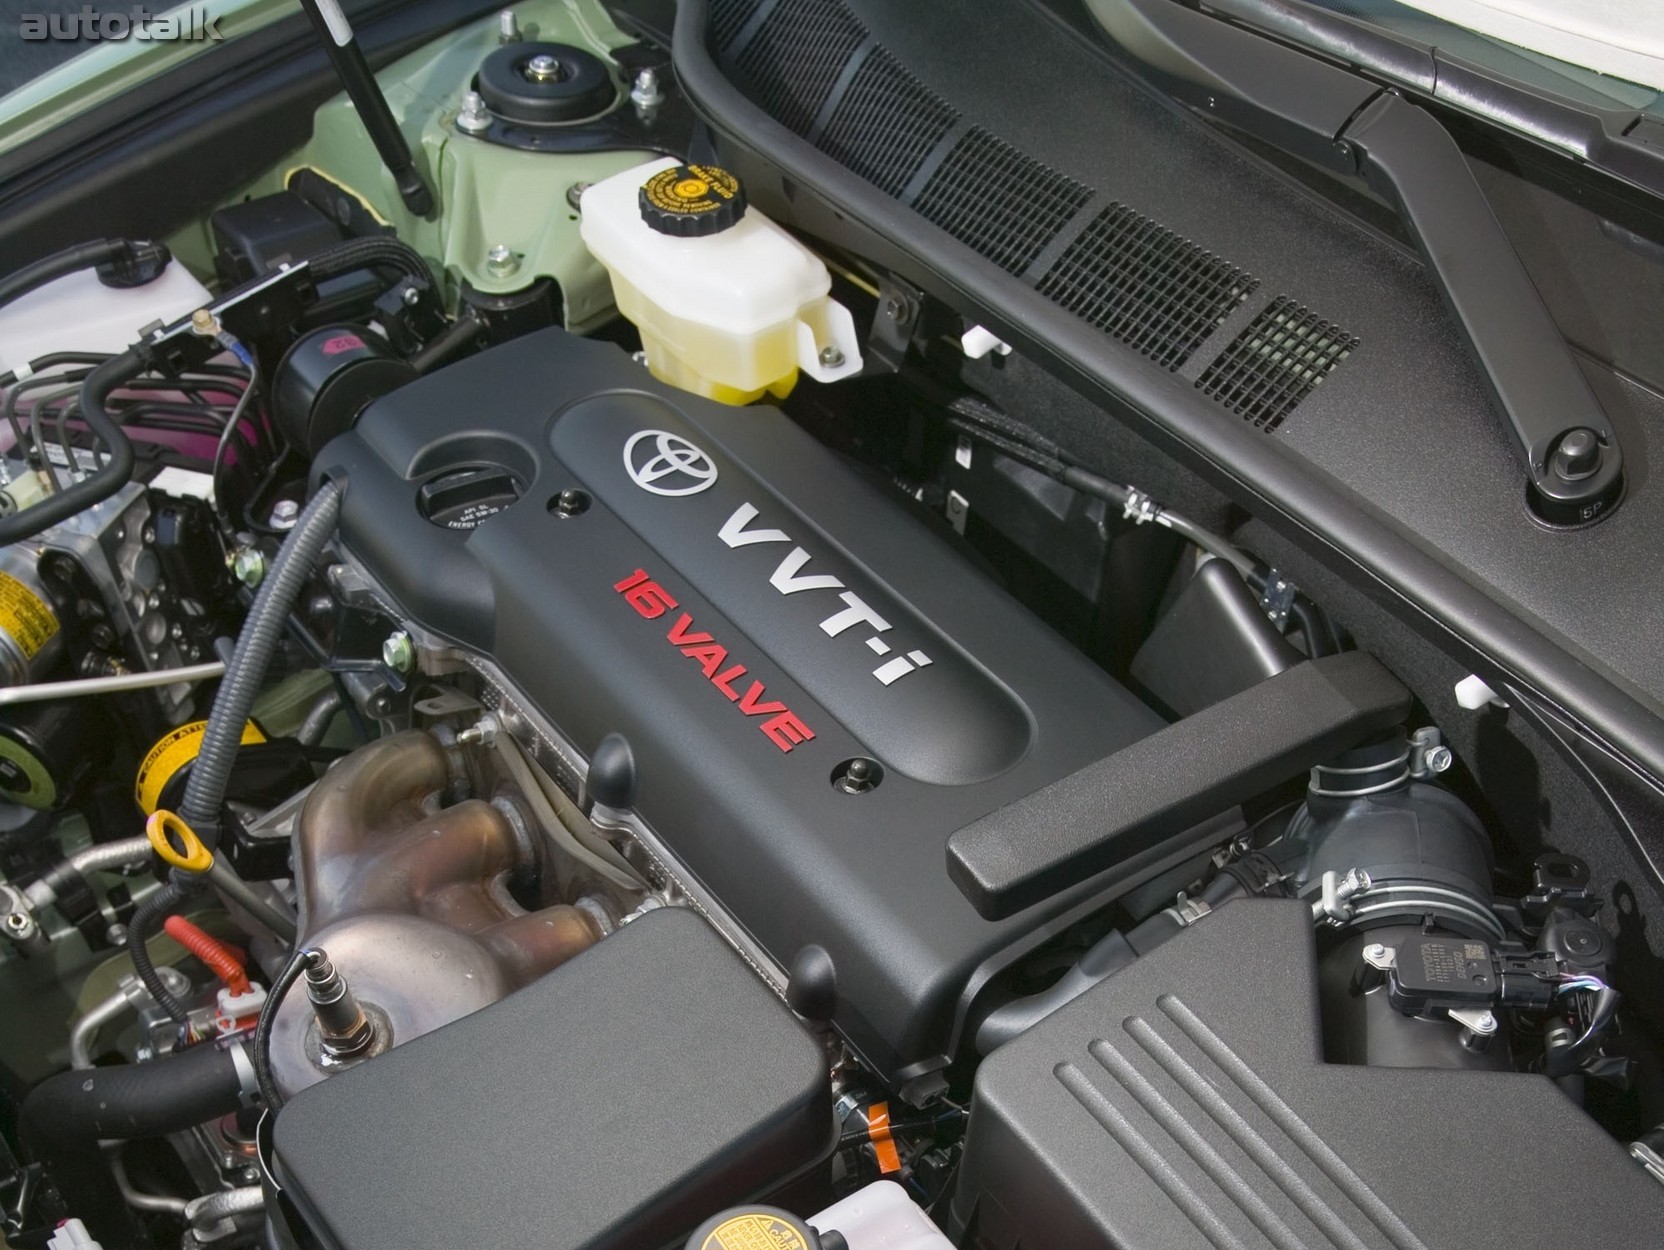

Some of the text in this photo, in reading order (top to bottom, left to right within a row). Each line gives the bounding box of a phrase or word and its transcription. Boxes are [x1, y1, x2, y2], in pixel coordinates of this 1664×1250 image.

[710, 181, 733, 199] FLUID
[448, 520, 475, 528] ENERGY
[717, 501, 934, 687] VVT-i
[613, 568, 817, 754] 16 VALVE
[143, 735, 176, 773] CAUTION
[1421, 943, 1436, 982] TOYOTA
[1453, 951, 1467, 979] DENSO
